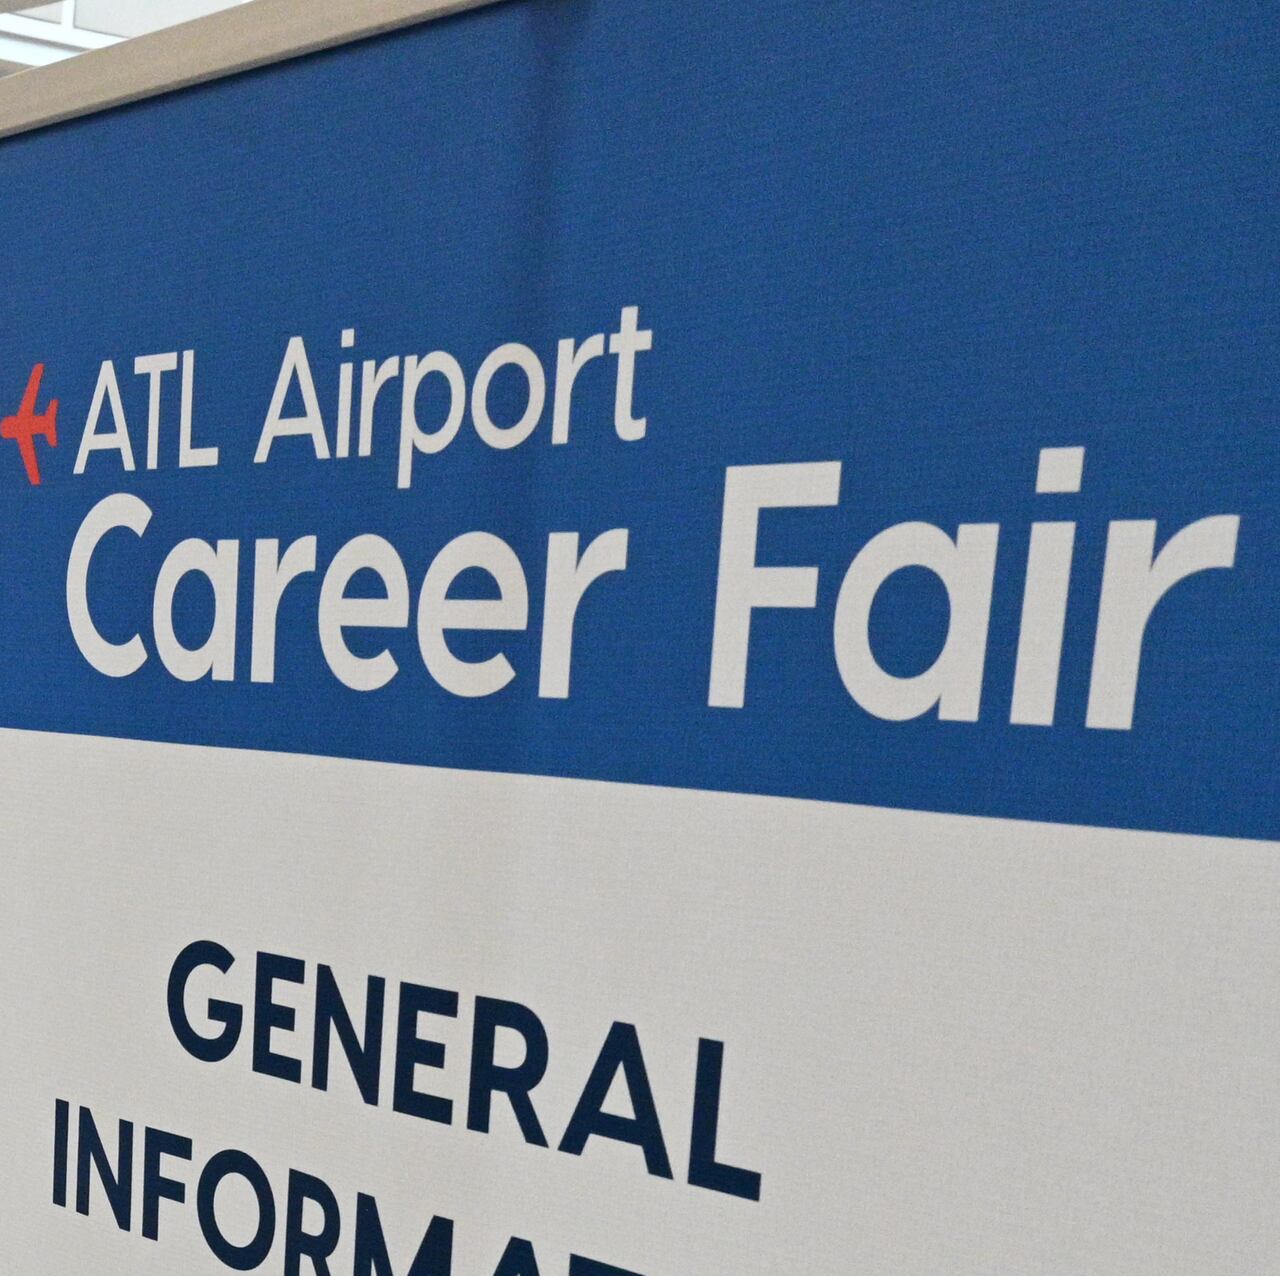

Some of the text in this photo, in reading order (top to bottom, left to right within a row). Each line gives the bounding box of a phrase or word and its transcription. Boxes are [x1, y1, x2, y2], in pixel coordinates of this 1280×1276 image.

[74, 305, 653, 489] ATL Airport
[65, 445, 1240, 731] Career Fair
[166, 940, 762, 1202] GENERAL
